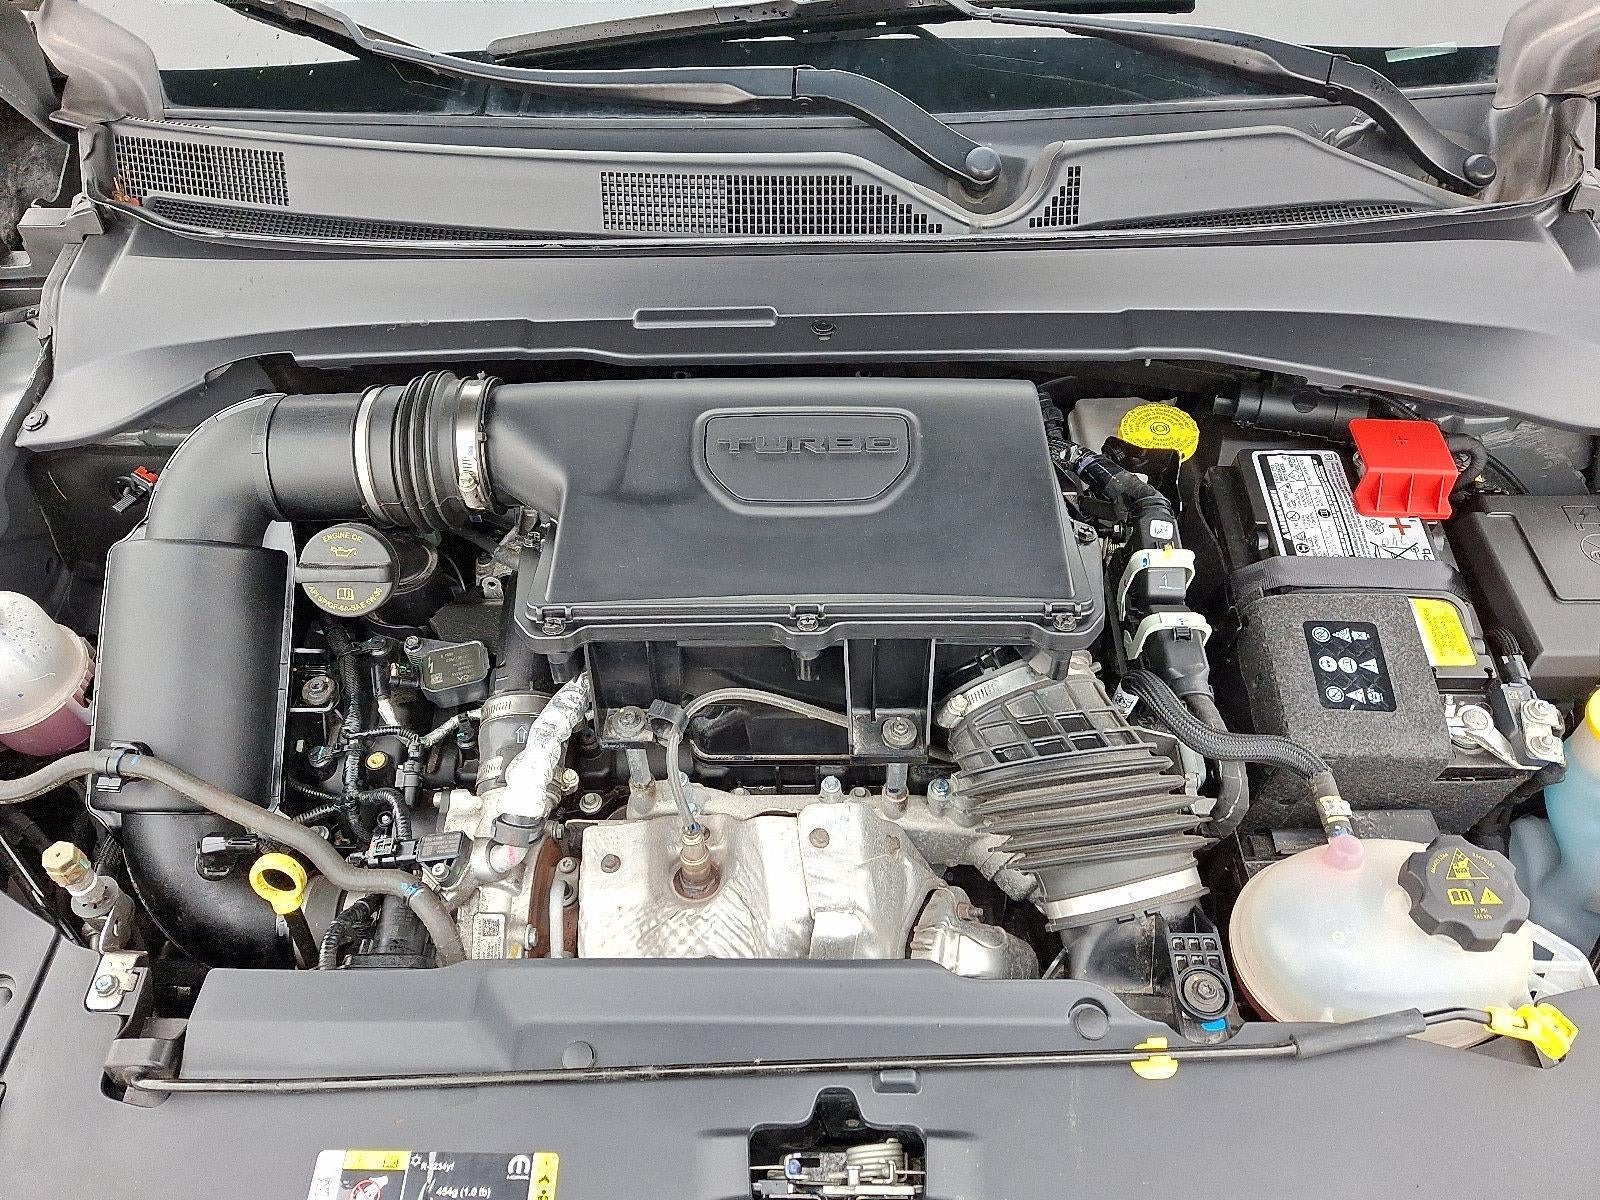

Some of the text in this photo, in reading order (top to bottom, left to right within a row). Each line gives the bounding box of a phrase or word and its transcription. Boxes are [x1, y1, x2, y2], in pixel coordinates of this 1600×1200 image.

[717, 436, 899, 454] TURBO
[324, 532, 363, 543] ENGINE OIL
[308, 586, 318, 597] API
